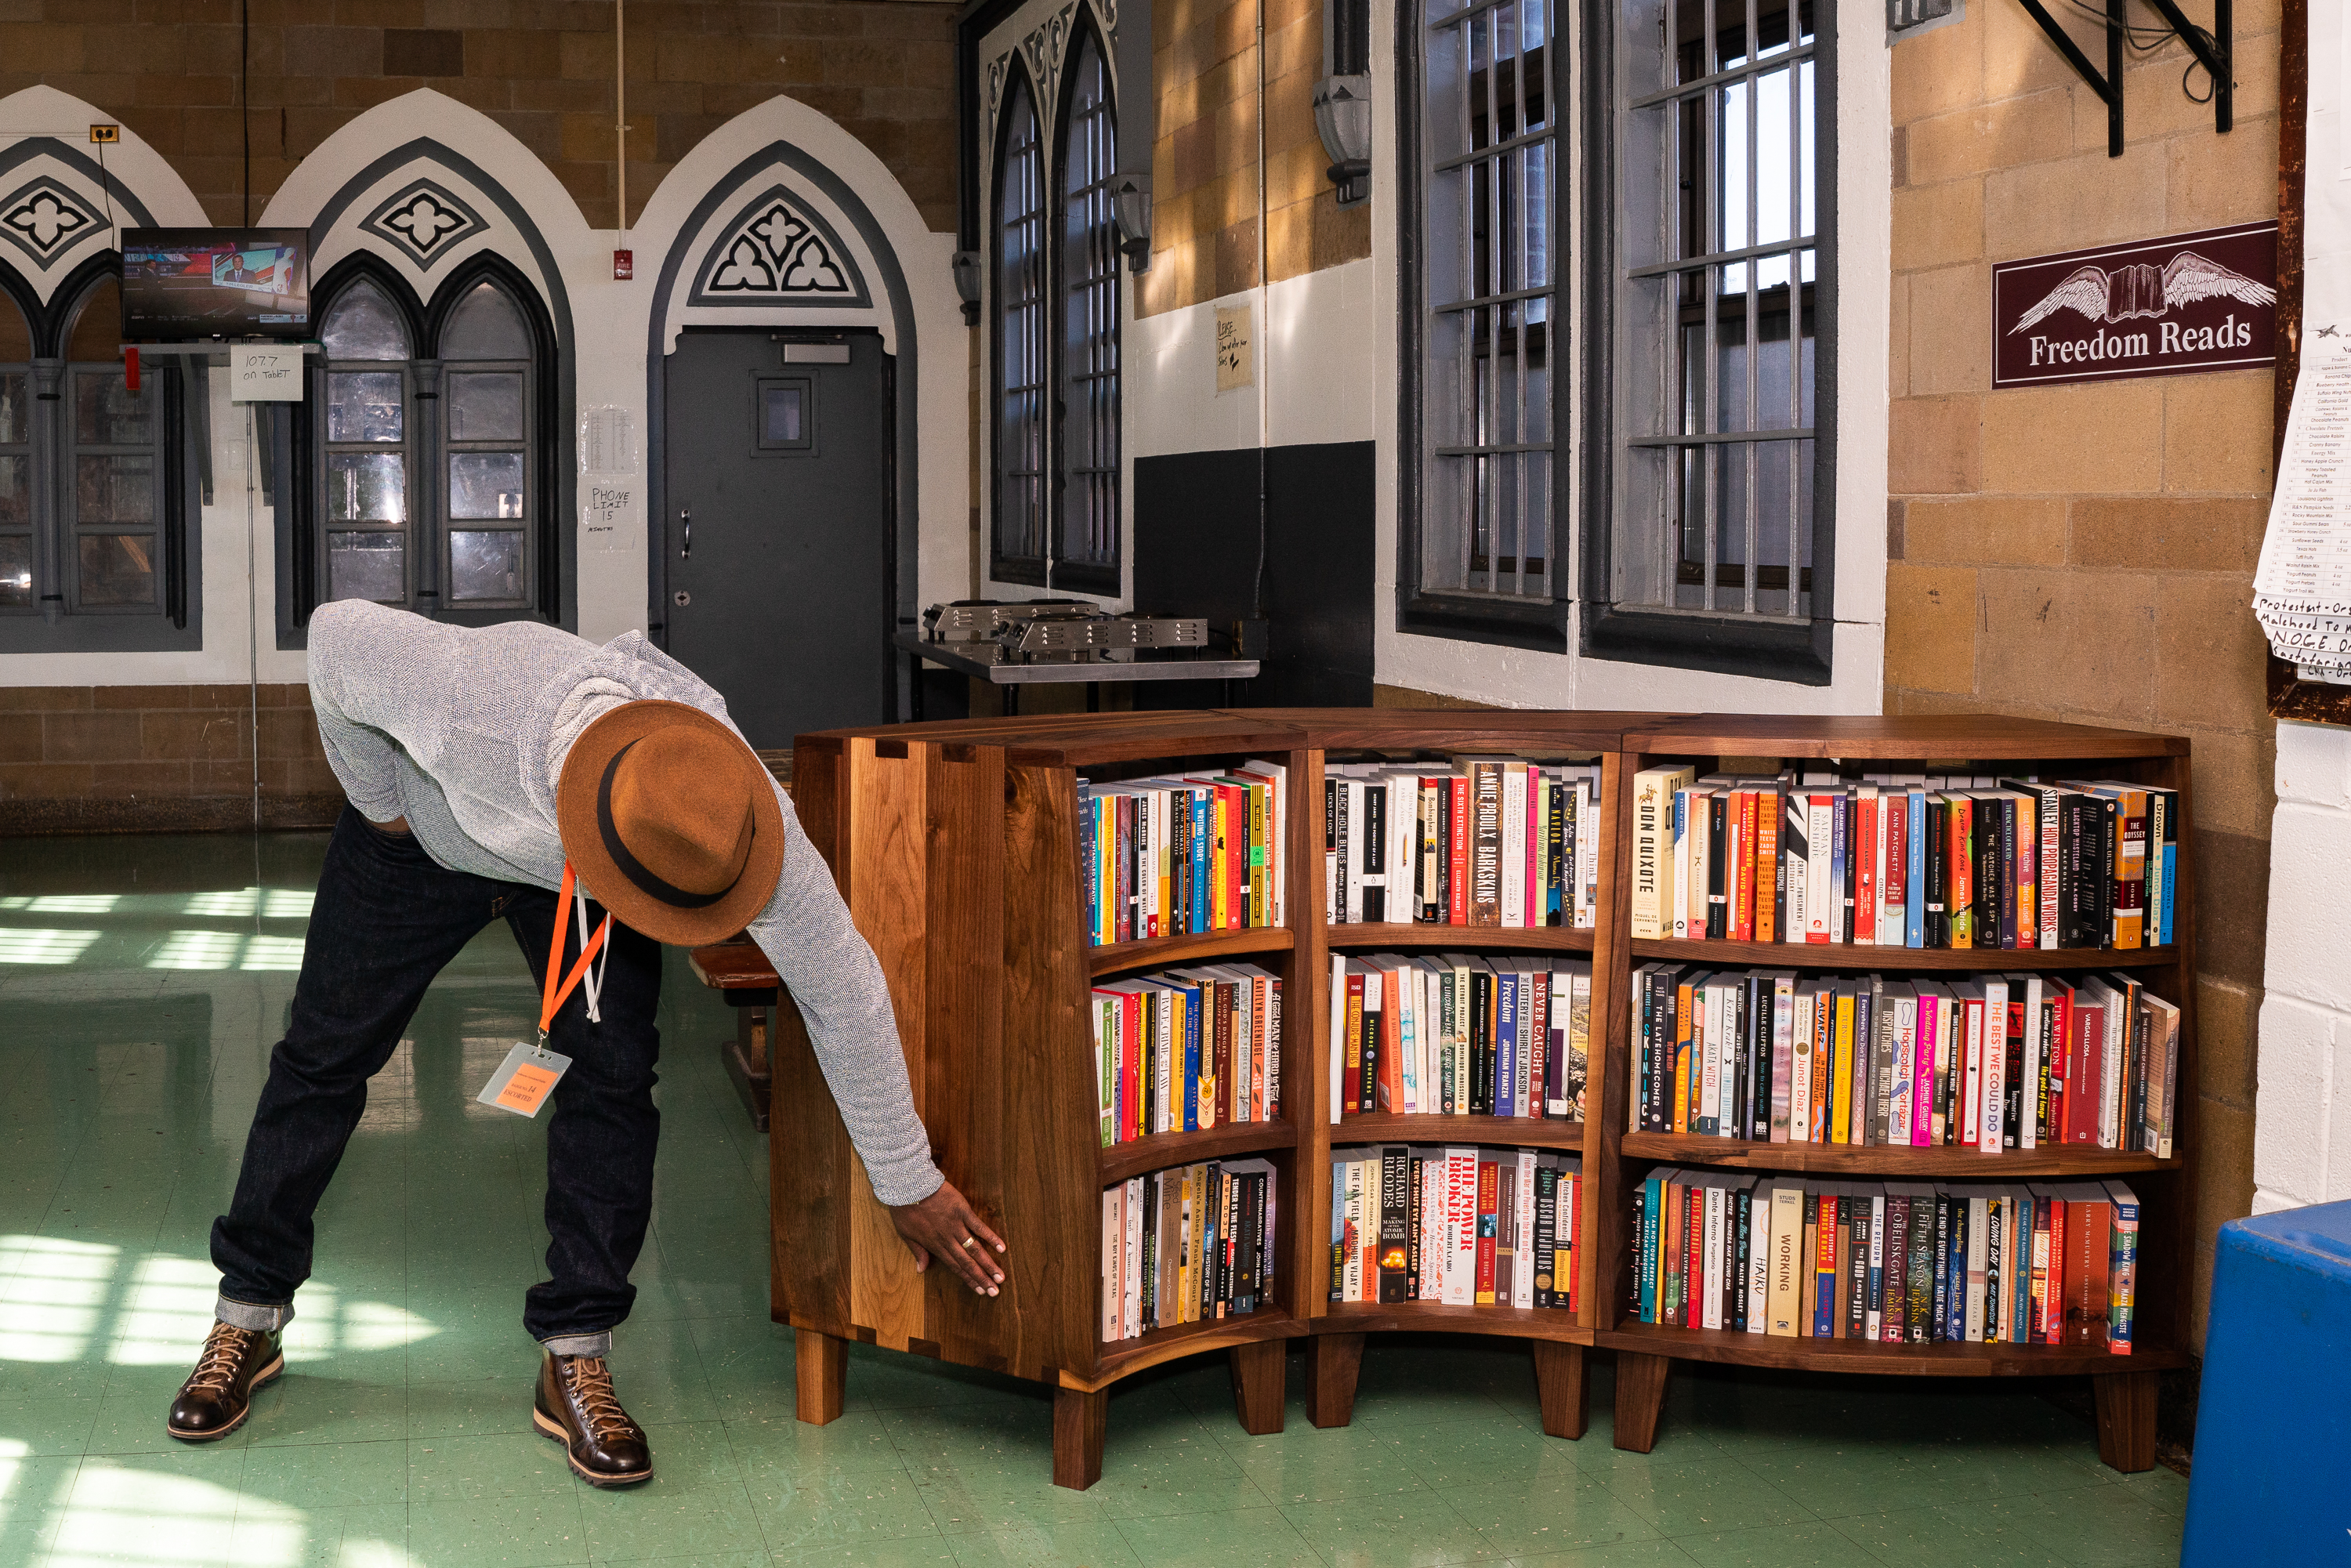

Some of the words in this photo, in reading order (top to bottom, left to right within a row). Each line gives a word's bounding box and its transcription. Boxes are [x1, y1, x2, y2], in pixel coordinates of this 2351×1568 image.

[2030, 328, 2150, 366] Freedom
[2159, 314, 2251, 354] Reads
[243, 371, 256, 380] on
[246, 356, 277, 368] 107.7
[592, 488, 630, 502] PHONE
[593, 501, 628, 509] LIMIT
[603, 511, 614, 521] 15
[2326, 621, 2339, 632] To
[1480, 772, 1498, 799] ANNIE
[1480, 802, 1497, 838] PROULX
[1640, 806, 1655, 831] DON
[2042, 789, 2058, 825] STANLEY
[1550, 809, 1561, 843] NAYLOR
[2042, 827, 2057, 841] HOW
[2124, 831, 2145, 839] ODYSSEY
[1477, 846, 1497, 904] BARKSKINS
[1588, 853, 1597, 878] Think
[1639, 838, 1654, 893] QUIXOTE
[2041, 843, 2057, 900] PROPAGANDA
[2041, 902, 2057, 932] WORKS
[1255, 980, 1263, 1011] KAITLYN
[1502, 981, 1515, 1023] Freedom
[1520, 983, 1529, 1016] LOTTERY
[1534, 983, 1545, 1022] NEVER
[1991, 1001, 2002, 1023] THE
[1161, 1027, 1169, 1059] CRIME,
[1254, 1015, 1262, 1056] GREENIDGE
[1350, 1011, 1360, 1048] CONJURE-MAN
[1520, 1029, 1528, 1056] SHIRLEY
[1882, 1011, 1894, 1053] DISPATCHES
[1991, 1024, 2001, 1050] BEST
[2052, 1024, 2061, 1065] WINTON
[1349, 1051, 1358, 1064] DIES
[1533, 1025, 1544, 1075] CAUGHT
[1900, 1027, 1912, 1079] Hopscotch
[1990, 1052, 2001, 1071] WE
[1518, 1059, 1527, 1095] JACKSON
[1653, 1026, 1662, 1106] LATEHOMECOMER
[504, 1089, 531, 1102] ESCORTED
[1878, 1067, 1891, 1098] MICHAEL
[1988, 1073, 2000, 1113] COULD
[1878, 1099, 1889, 1117] HERR
[1899, 1087, 1909, 1130] Cortázar
[1987, 1114, 1998, 1132] DO
[1384, 1156, 1395, 1208] RHODES
[1396, 1156, 1406, 1208] RICHARD
[1462, 1153, 1475, 1192] THE
[1447, 1156, 1462, 1223] BROKER
[1460, 1193, 1475, 1251] POWER
[1539, 1198, 1553, 1225] OSCAR
[1891, 1214, 1902, 1262] OBELISK
[1918, 1214, 1929, 1243] FIFTH
[1991, 1215, 2000, 1246] LOVING
[1538, 1229, 1552, 1270] HIJUELOS
[1779, 1234, 1791, 1291] WORKING
[1989, 1247, 1998, 1266] DAY
[2123, 1235, 2132, 1262] SHADOW
[1349, 1264, 1358, 1286] VIJAY
[1755, 1257, 1766, 1295] HAIKU
[1890, 1262, 1900, 1286] GATE
[1916, 1244, 1928, 1287] SEASON
[2121, 1261, 2130, 1276] KING
[1886, 1289, 1896, 1323] JEMISIN
[2120, 1288, 2129, 1309] MAAZA
[2119, 1309, 2128, 1334] MENGISTE
